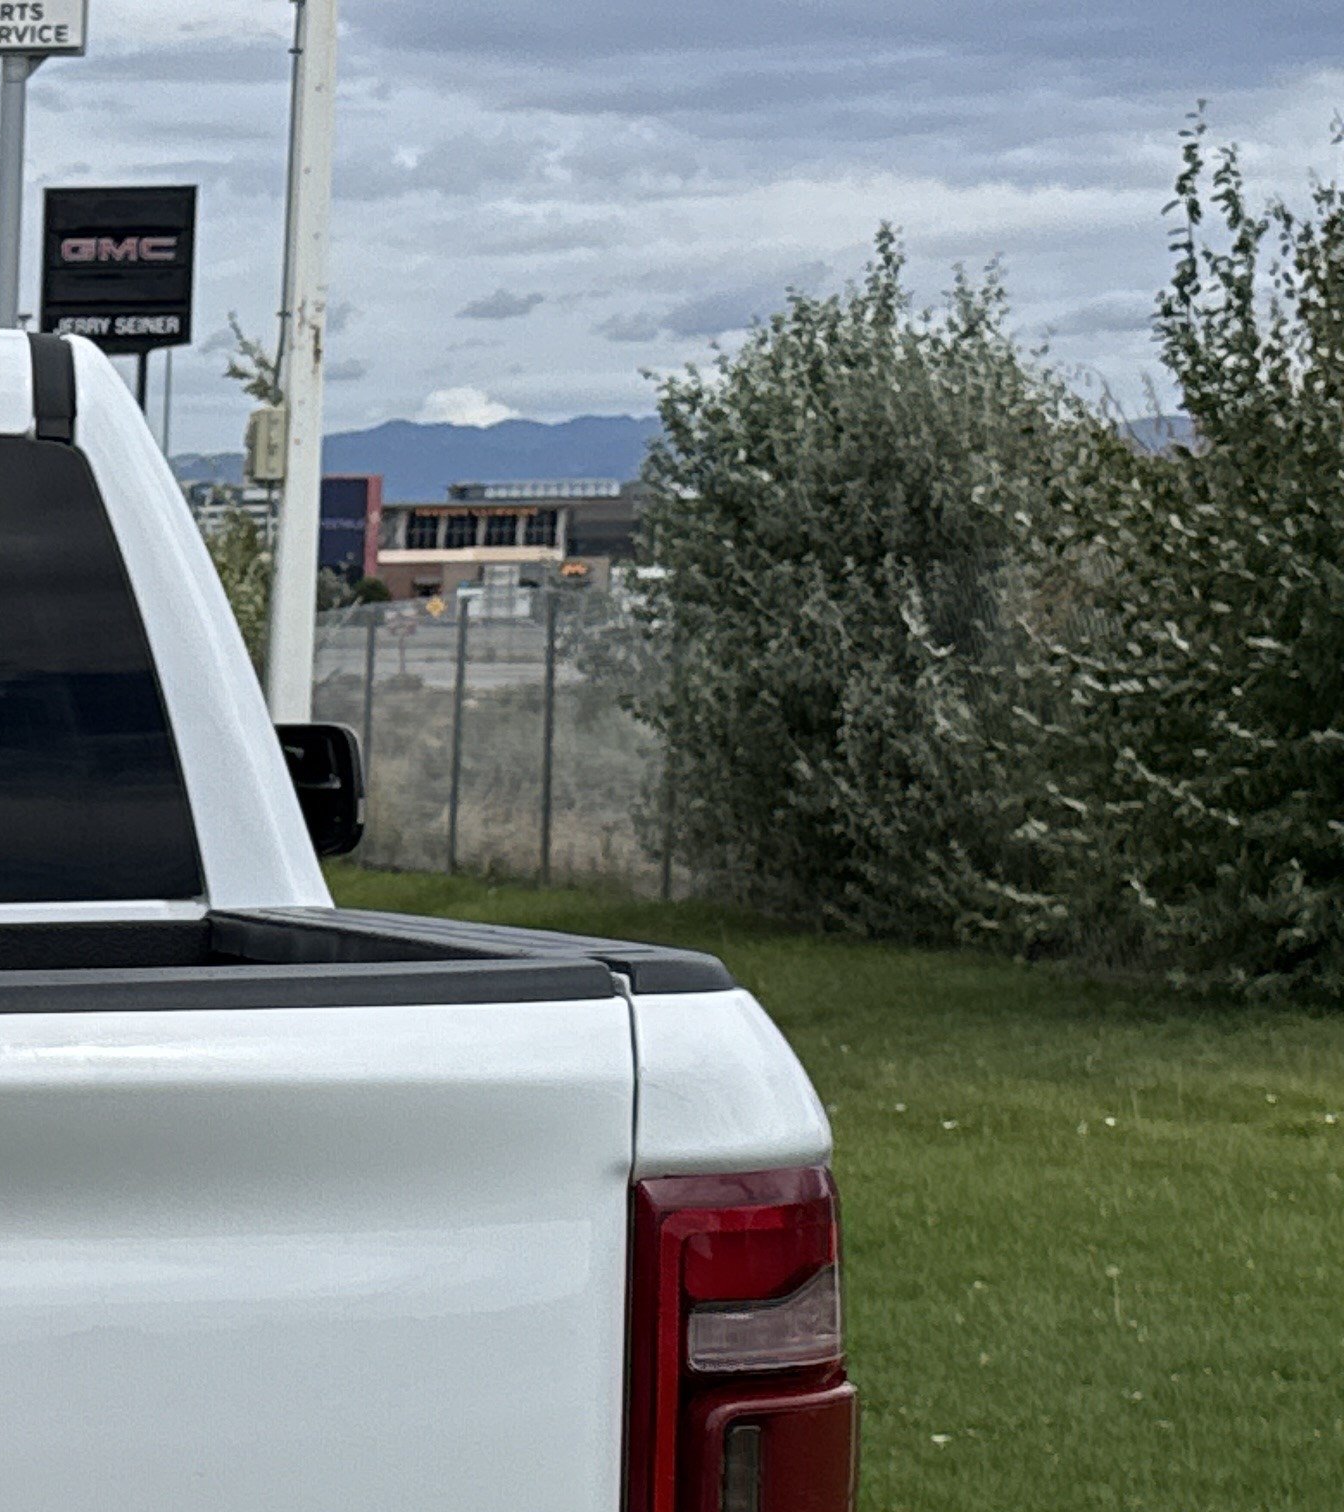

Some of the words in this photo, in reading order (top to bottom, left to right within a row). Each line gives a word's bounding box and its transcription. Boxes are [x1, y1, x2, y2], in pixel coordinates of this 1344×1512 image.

[61, 236, 177, 262] GMC
[53, 316, 111, 335] JERRY
[114, 315, 180, 335] SEINER
